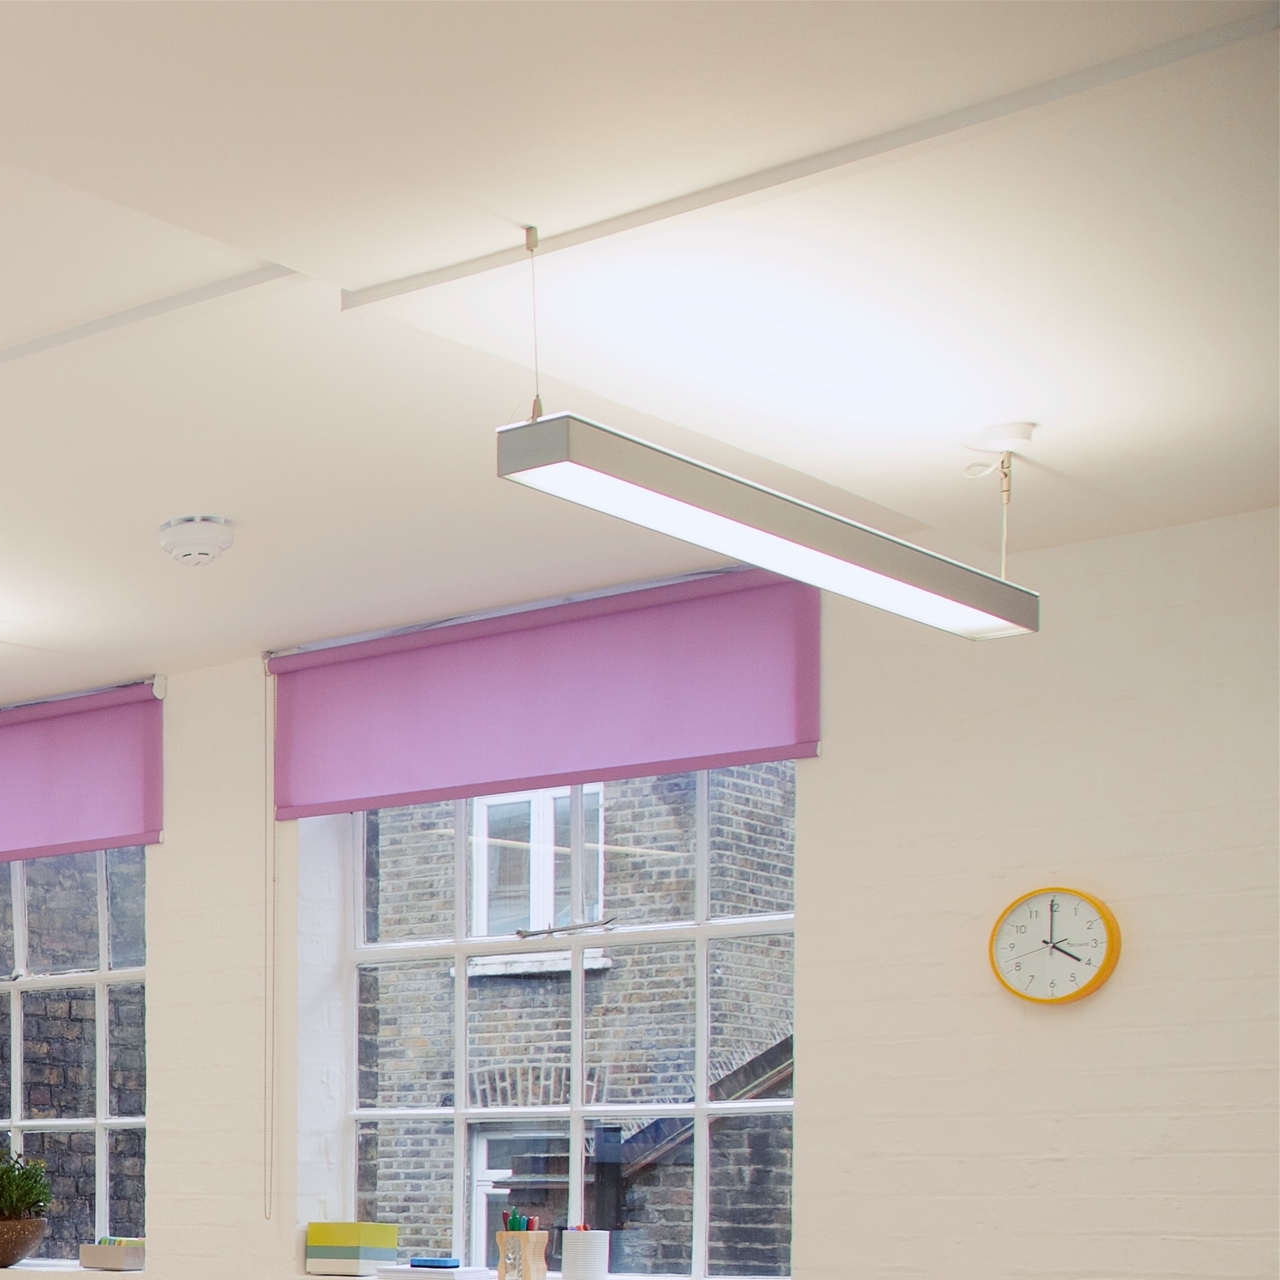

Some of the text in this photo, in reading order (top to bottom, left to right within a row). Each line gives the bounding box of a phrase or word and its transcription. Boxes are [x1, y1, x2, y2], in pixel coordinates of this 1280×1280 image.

[1029, 910, 1038, 919] 11
[1016, 925, 1026, 934] 10
[1086, 921, 1093, 930] 2
[1009, 943, 1015, 951] 9
[1091, 939, 1097, 948] 3
[1014, 962, 1021, 971] 8
[1085, 958, 1091, 966] 4
[1069, 973, 1076, 982] 5
[1049, 979, 1055, 988] 6
